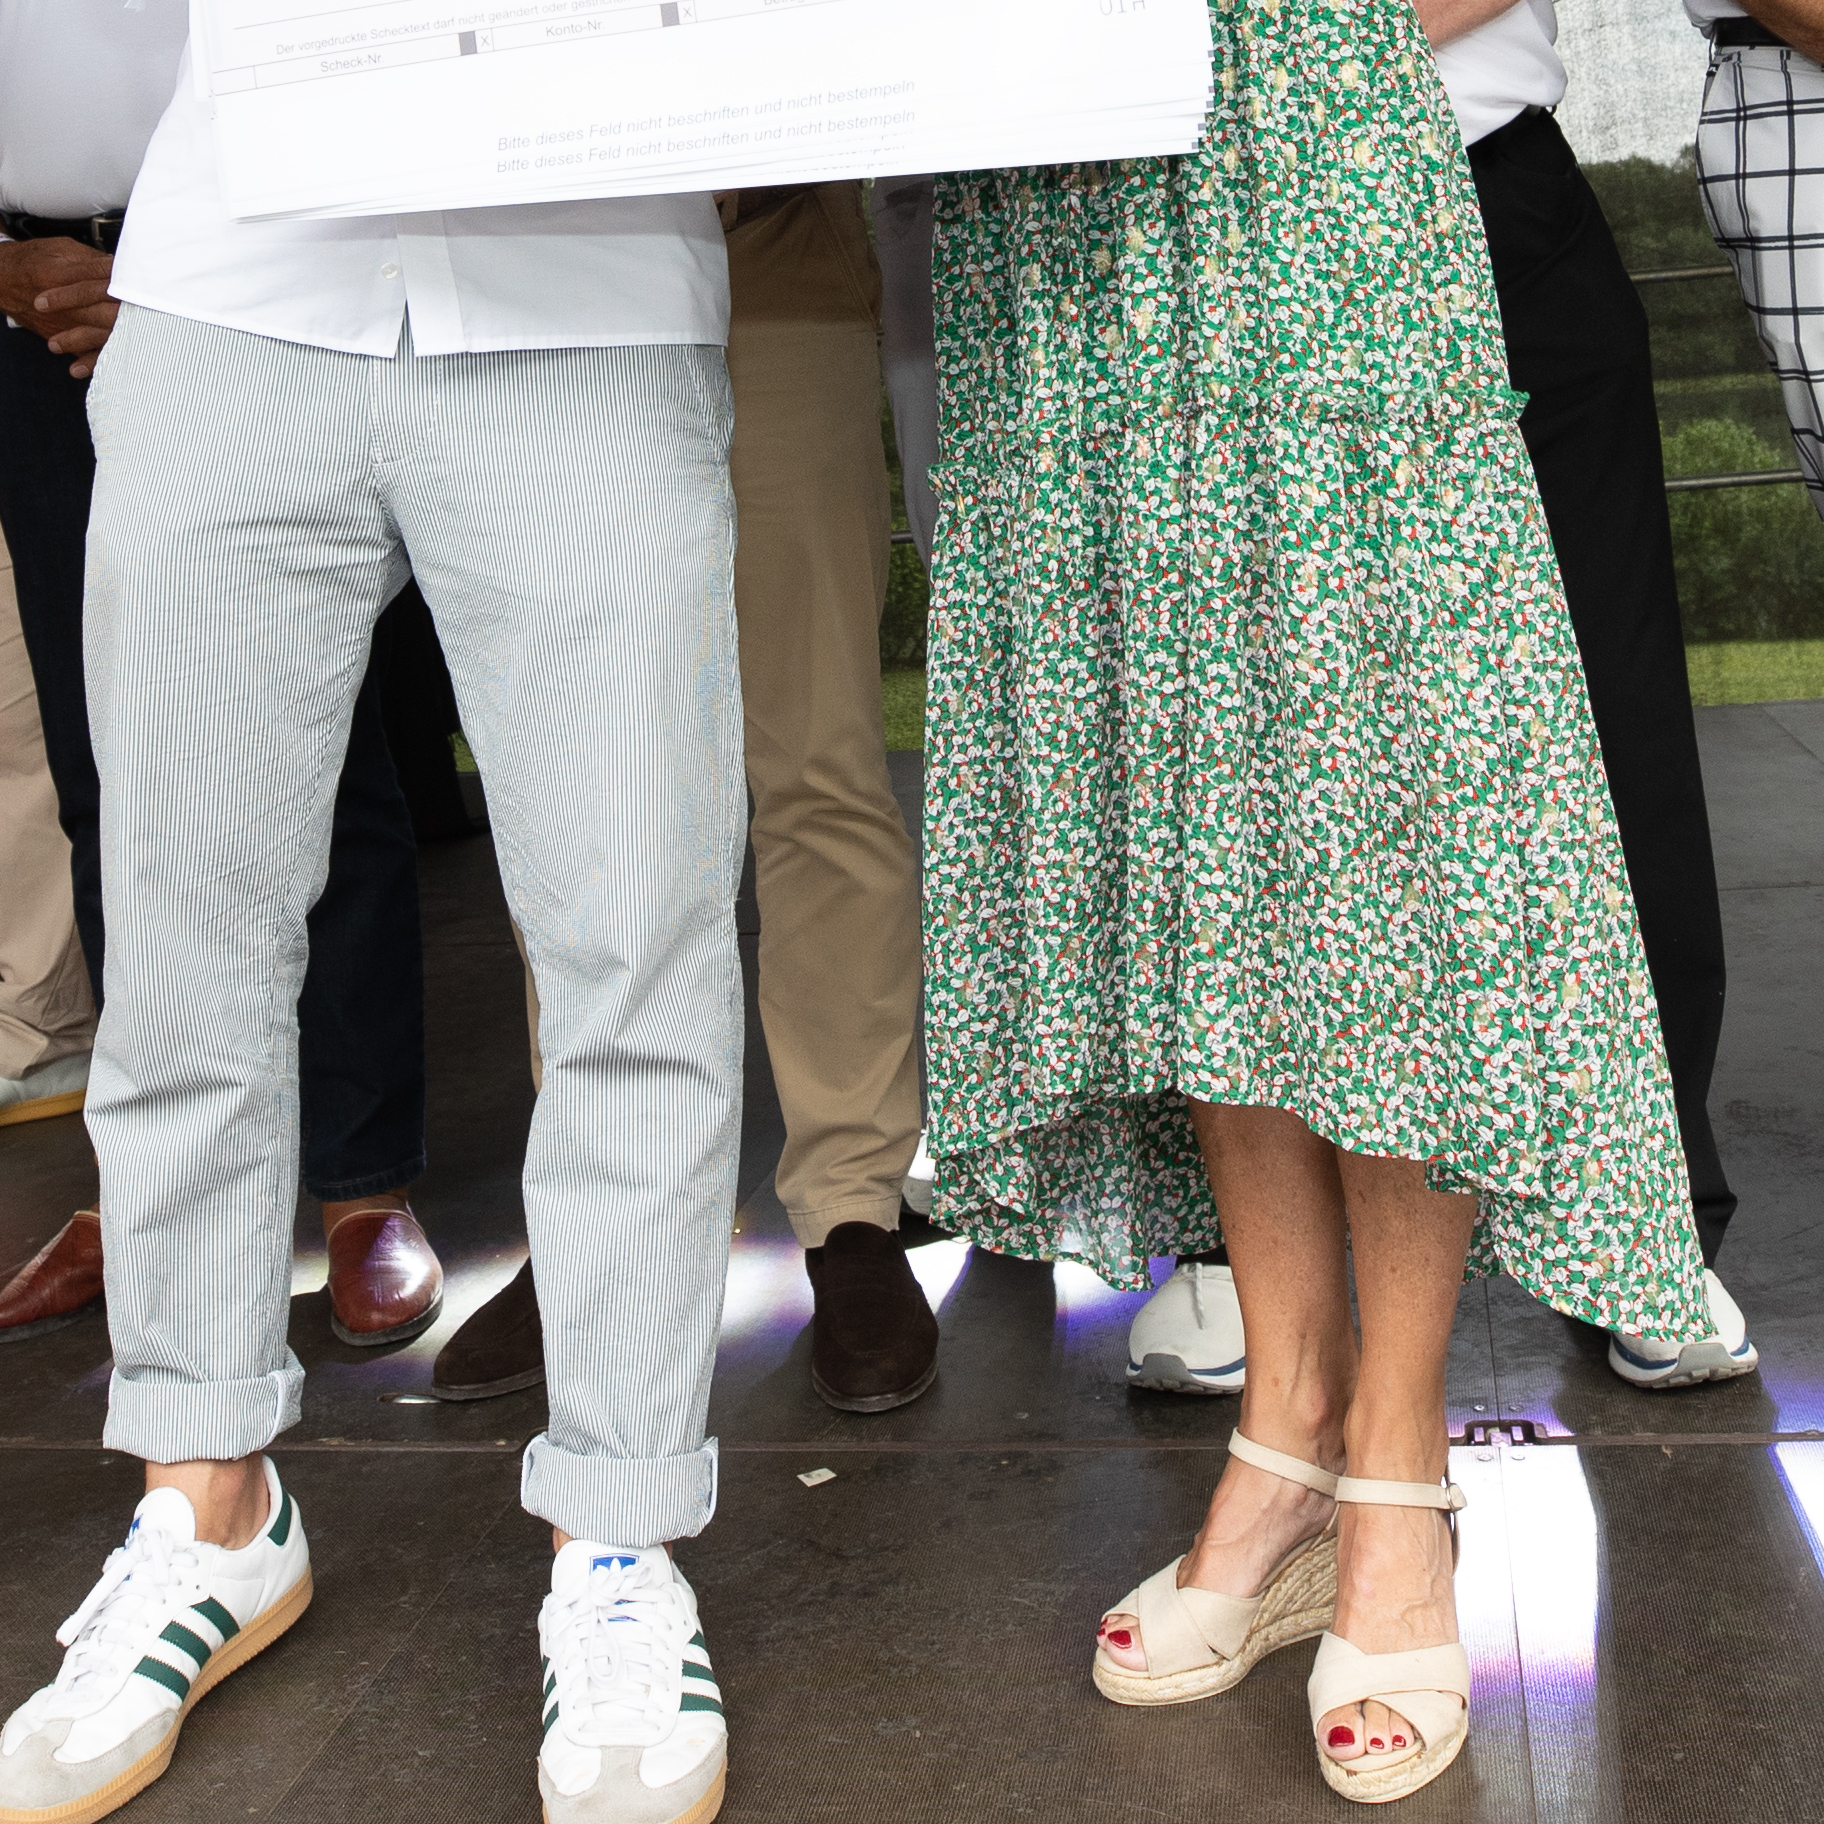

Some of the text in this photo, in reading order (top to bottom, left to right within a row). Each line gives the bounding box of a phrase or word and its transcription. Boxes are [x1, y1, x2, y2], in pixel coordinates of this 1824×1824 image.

[276, 43, 296, 55] Der
[299, 30, 368, 53] vorgedruckte
[370, 19, 431, 40] Schecktext
[434, 16, 455, 31] darf
[458, 11, 485, 27] nicht
[488, 5, 539, 24] geändert
[542, 0, 568, 14] oder
[320, 52, 384, 74] Scheck-Nr.
[546, 20, 605, 39] Konto-Nr.
[498, 79, 916, 151] Bitte dieses Feld nicht beschriften und nicht bestempeln
[534, 151, 583, 170] dieses
[588, 144, 622, 163] Feld
[625, 138, 662, 157] nicht
[666, 128, 750, 154] beschriften
[753, 124, 782, 144] und
[787, 119, 822, 138] nicht
[827, 109, 916, 135] bestempeln
